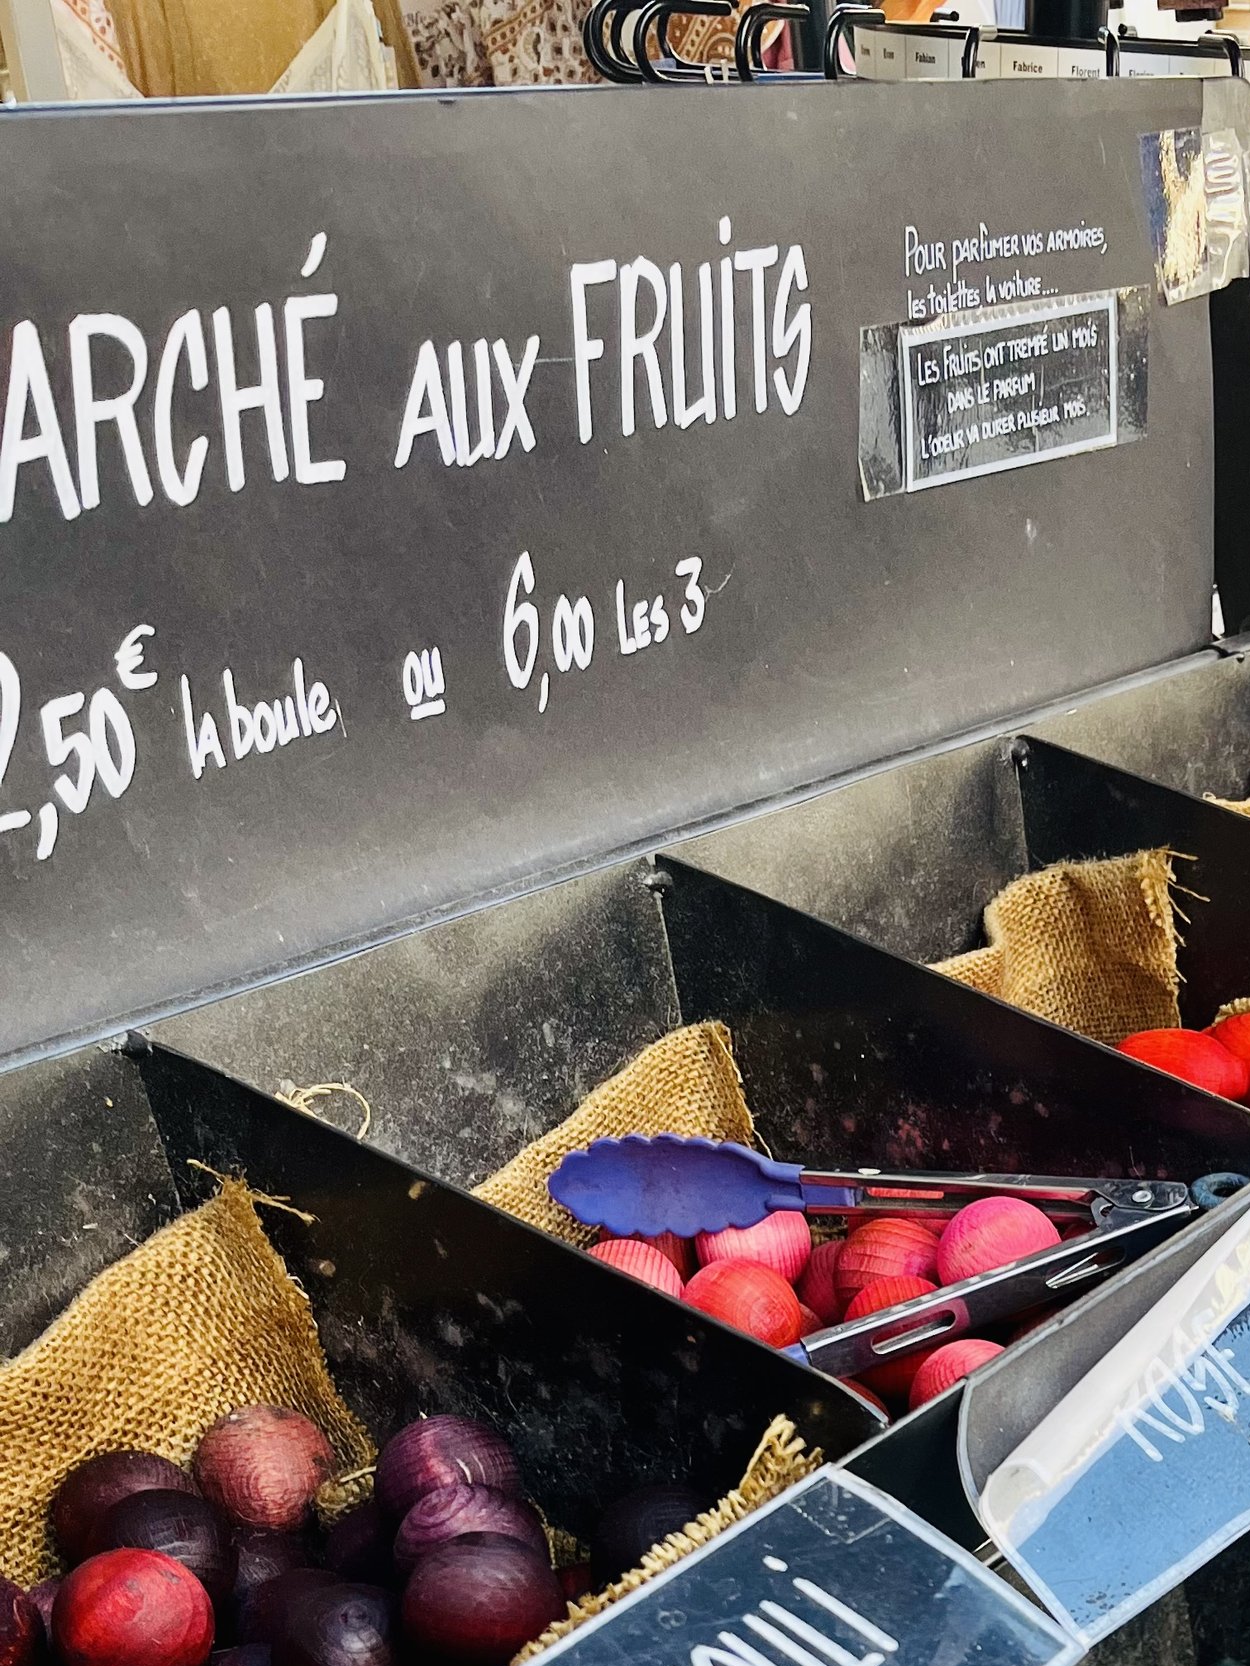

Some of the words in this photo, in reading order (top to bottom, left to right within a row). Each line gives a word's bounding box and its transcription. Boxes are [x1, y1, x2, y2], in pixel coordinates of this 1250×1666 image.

[1012, 60, 1044, 74] Fabrice
[1052, 333, 1069, 353] UN
[977, 384, 990, 405] LE
[674, 556, 705, 635] 3
